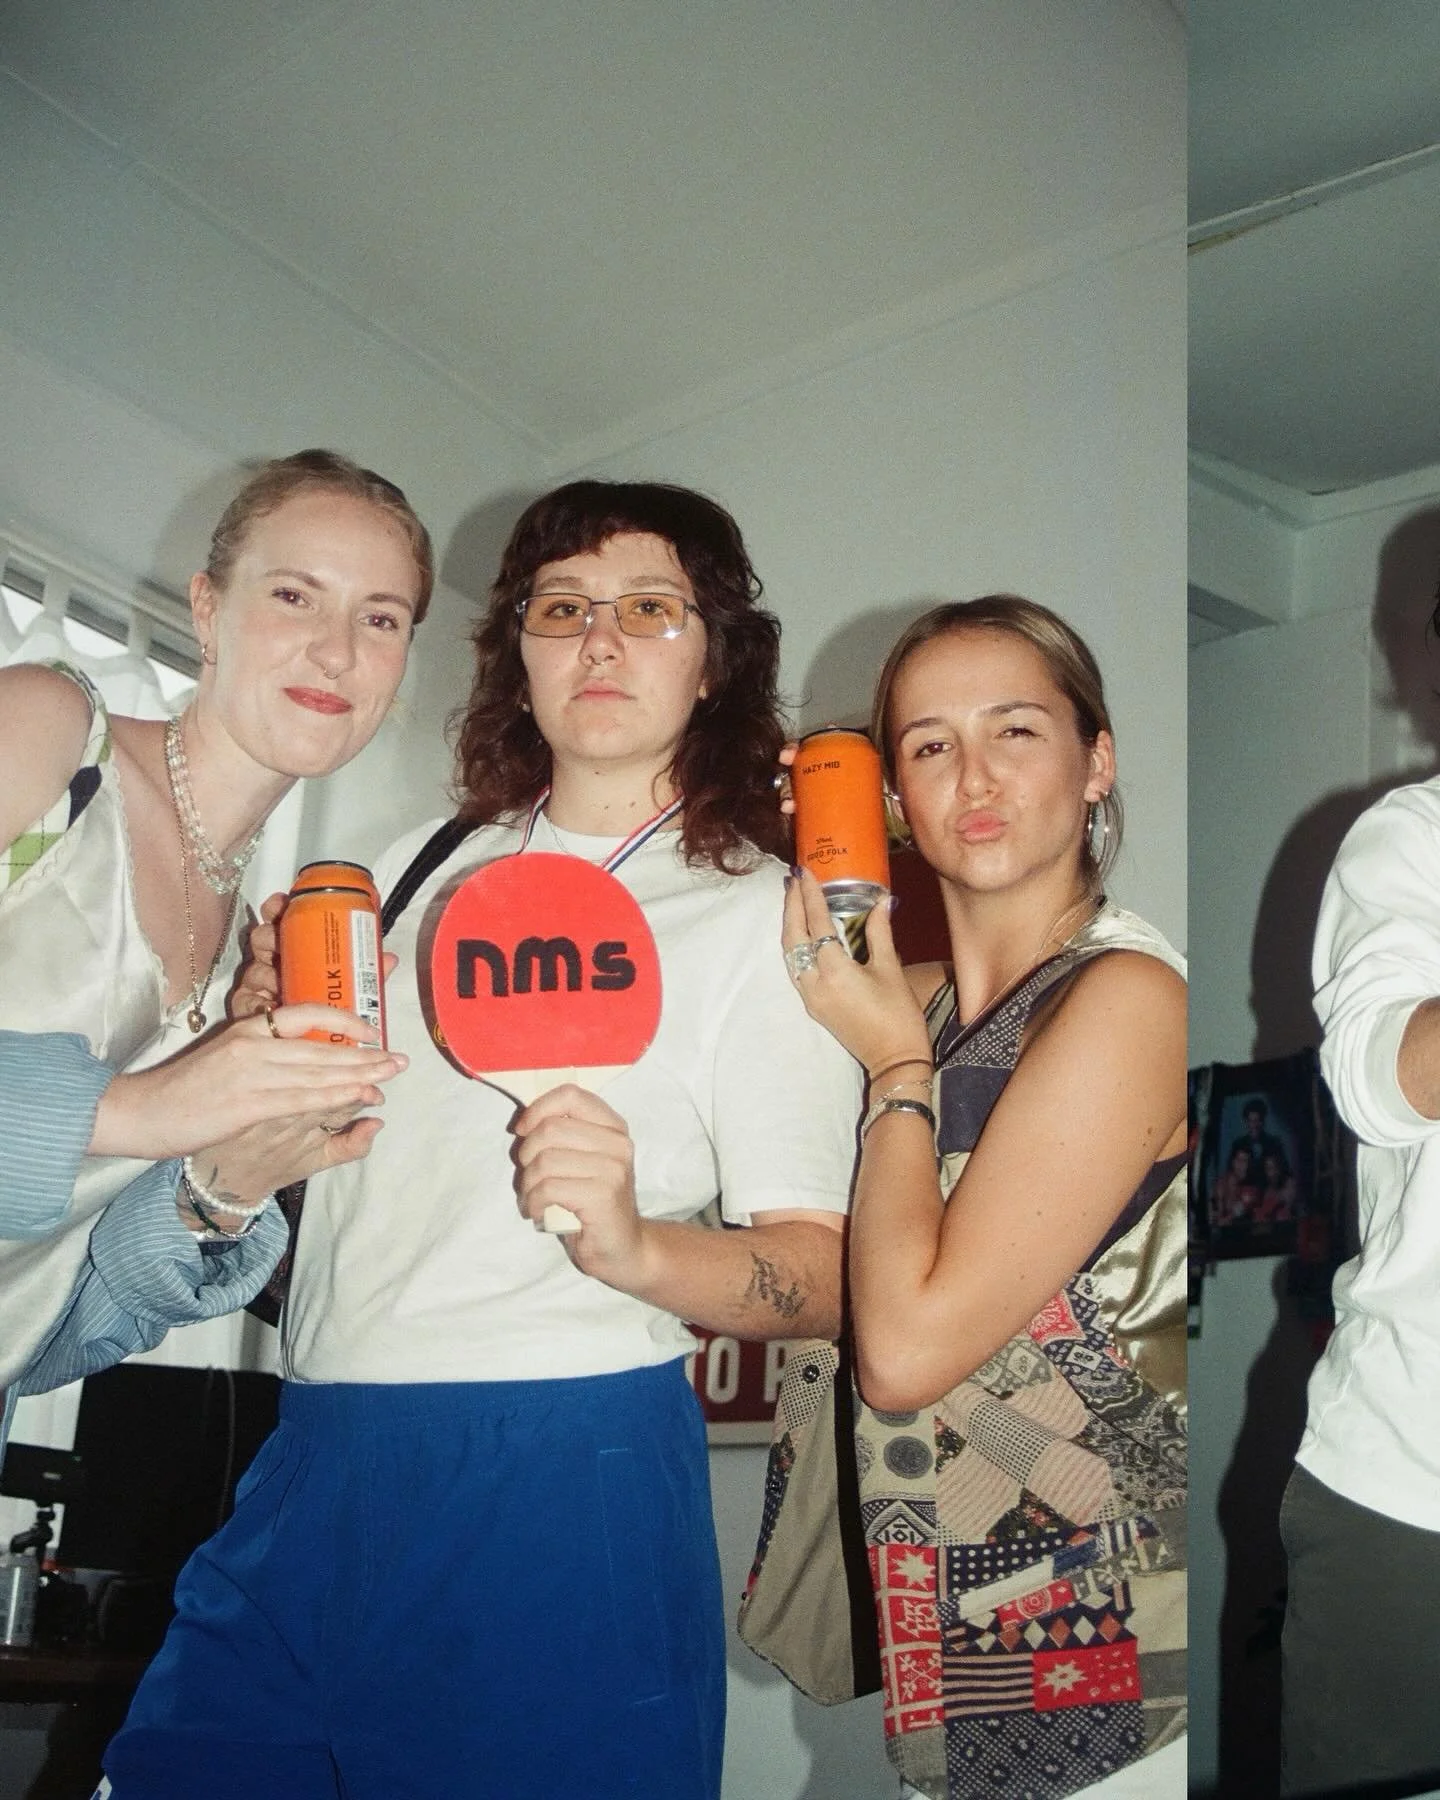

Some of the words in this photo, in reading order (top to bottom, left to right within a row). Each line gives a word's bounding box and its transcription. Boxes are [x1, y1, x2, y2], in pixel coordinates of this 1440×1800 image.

[802, 762, 822, 776] HAZY
[824, 760, 840, 769] MID
[827, 847, 848, 856] FOLK
[456, 936, 636, 998] nms
[328, 969, 342, 1009] OLK
